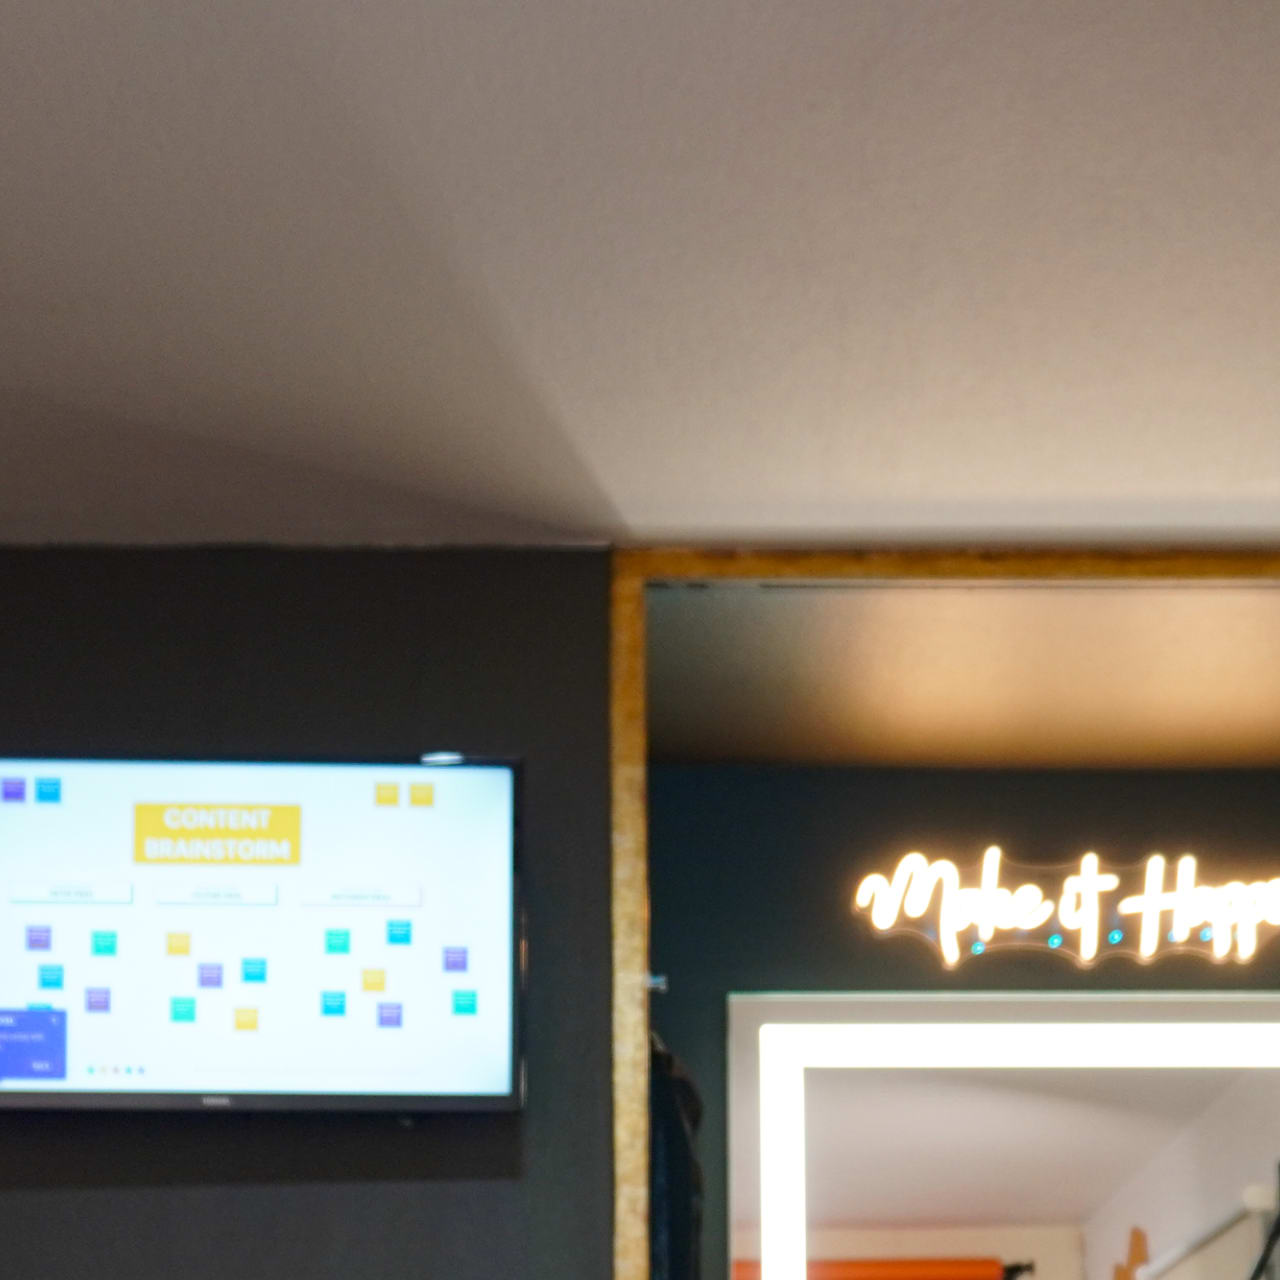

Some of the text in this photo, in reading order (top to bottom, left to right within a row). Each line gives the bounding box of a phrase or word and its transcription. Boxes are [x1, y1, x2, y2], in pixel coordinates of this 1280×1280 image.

[163, 807, 270, 830] CONTENT
[143, 837, 291, 861] BRAINSTORM
[856, 845, 1056, 966] Make
